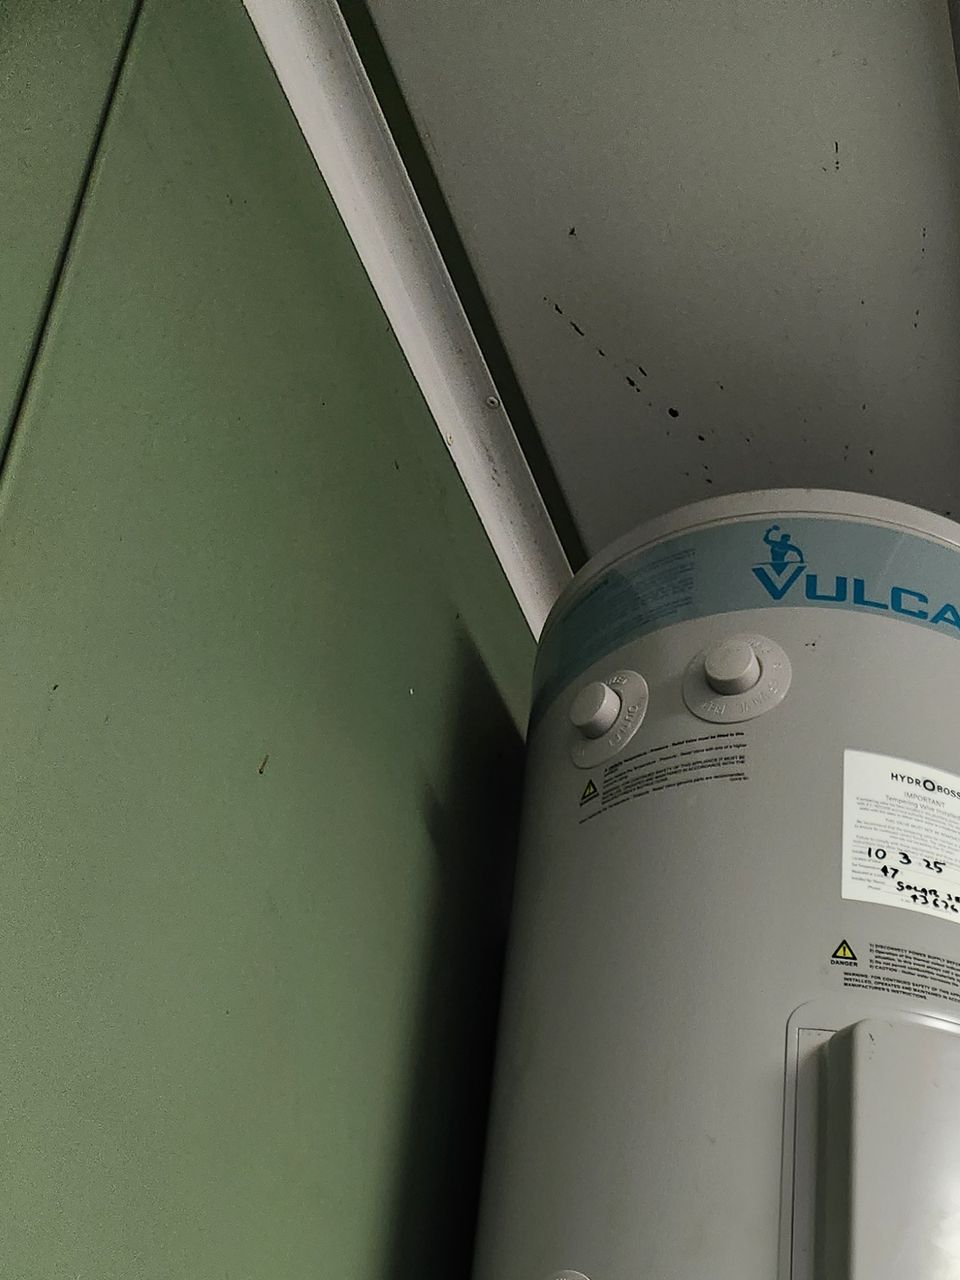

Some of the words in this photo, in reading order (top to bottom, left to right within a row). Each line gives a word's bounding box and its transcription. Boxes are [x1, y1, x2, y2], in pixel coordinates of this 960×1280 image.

[904, 791, 945, 807] IMPORTANT
[867, 847, 887, 860] 10
[899, 852, 912, 864] 3
[922, 859, 946, 873] 25
[830, 959, 858, 967] DANGER
